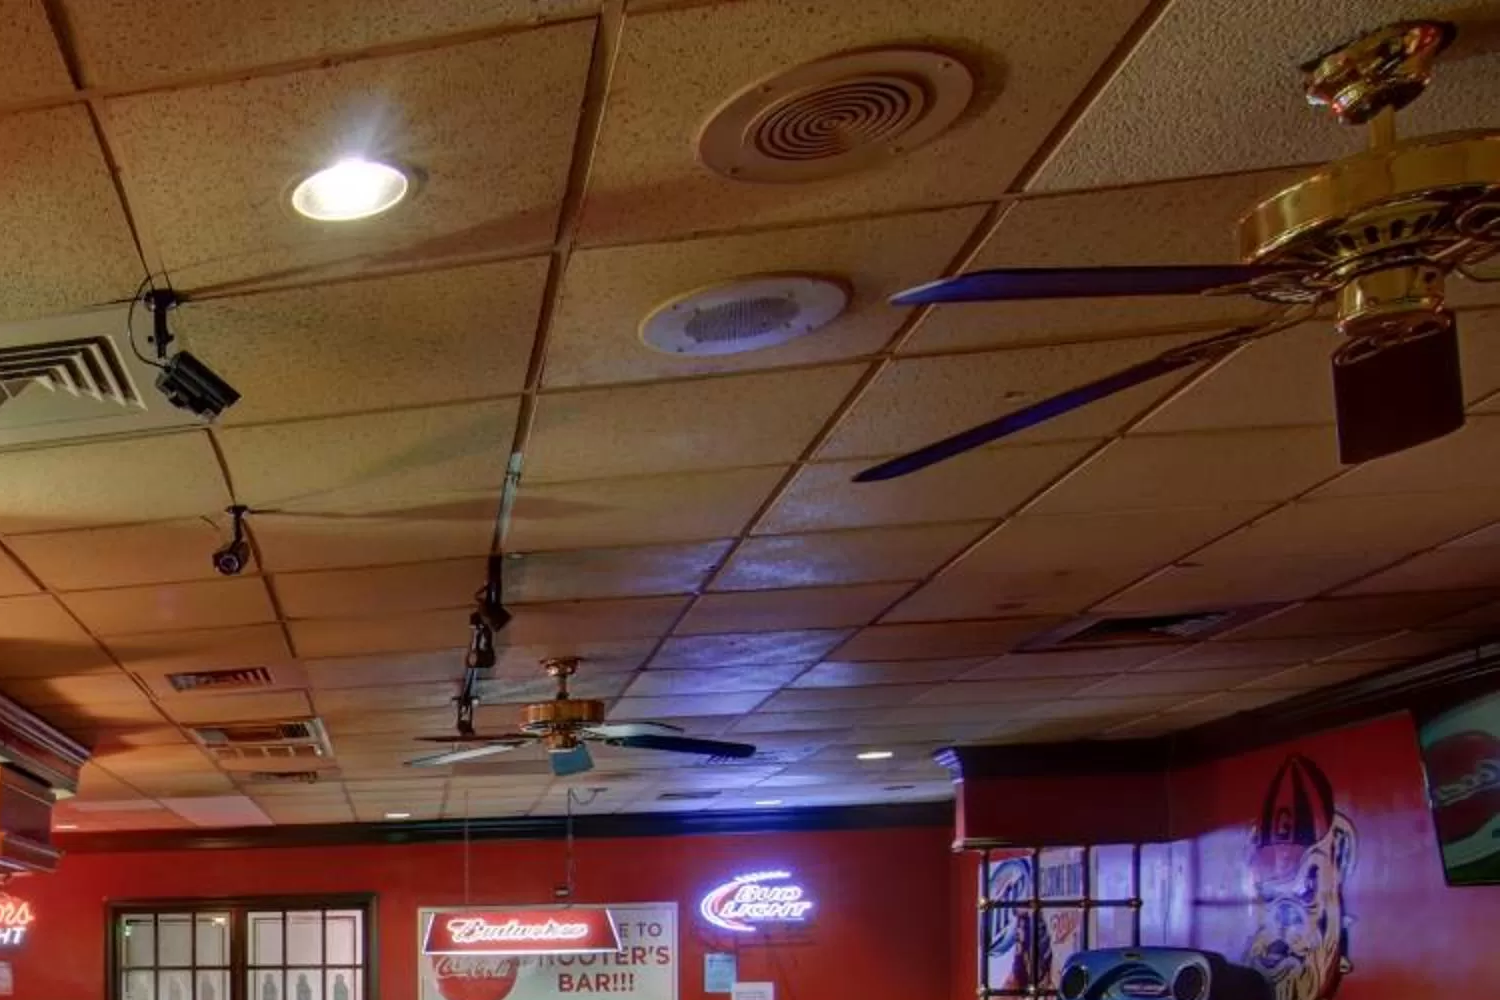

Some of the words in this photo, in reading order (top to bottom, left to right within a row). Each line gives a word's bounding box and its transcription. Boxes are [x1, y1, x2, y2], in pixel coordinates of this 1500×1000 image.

[447, 918, 588, 943] Budweiser
[636, 923, 663, 937] TO
[558, 973, 634, 993] BAR!!!
